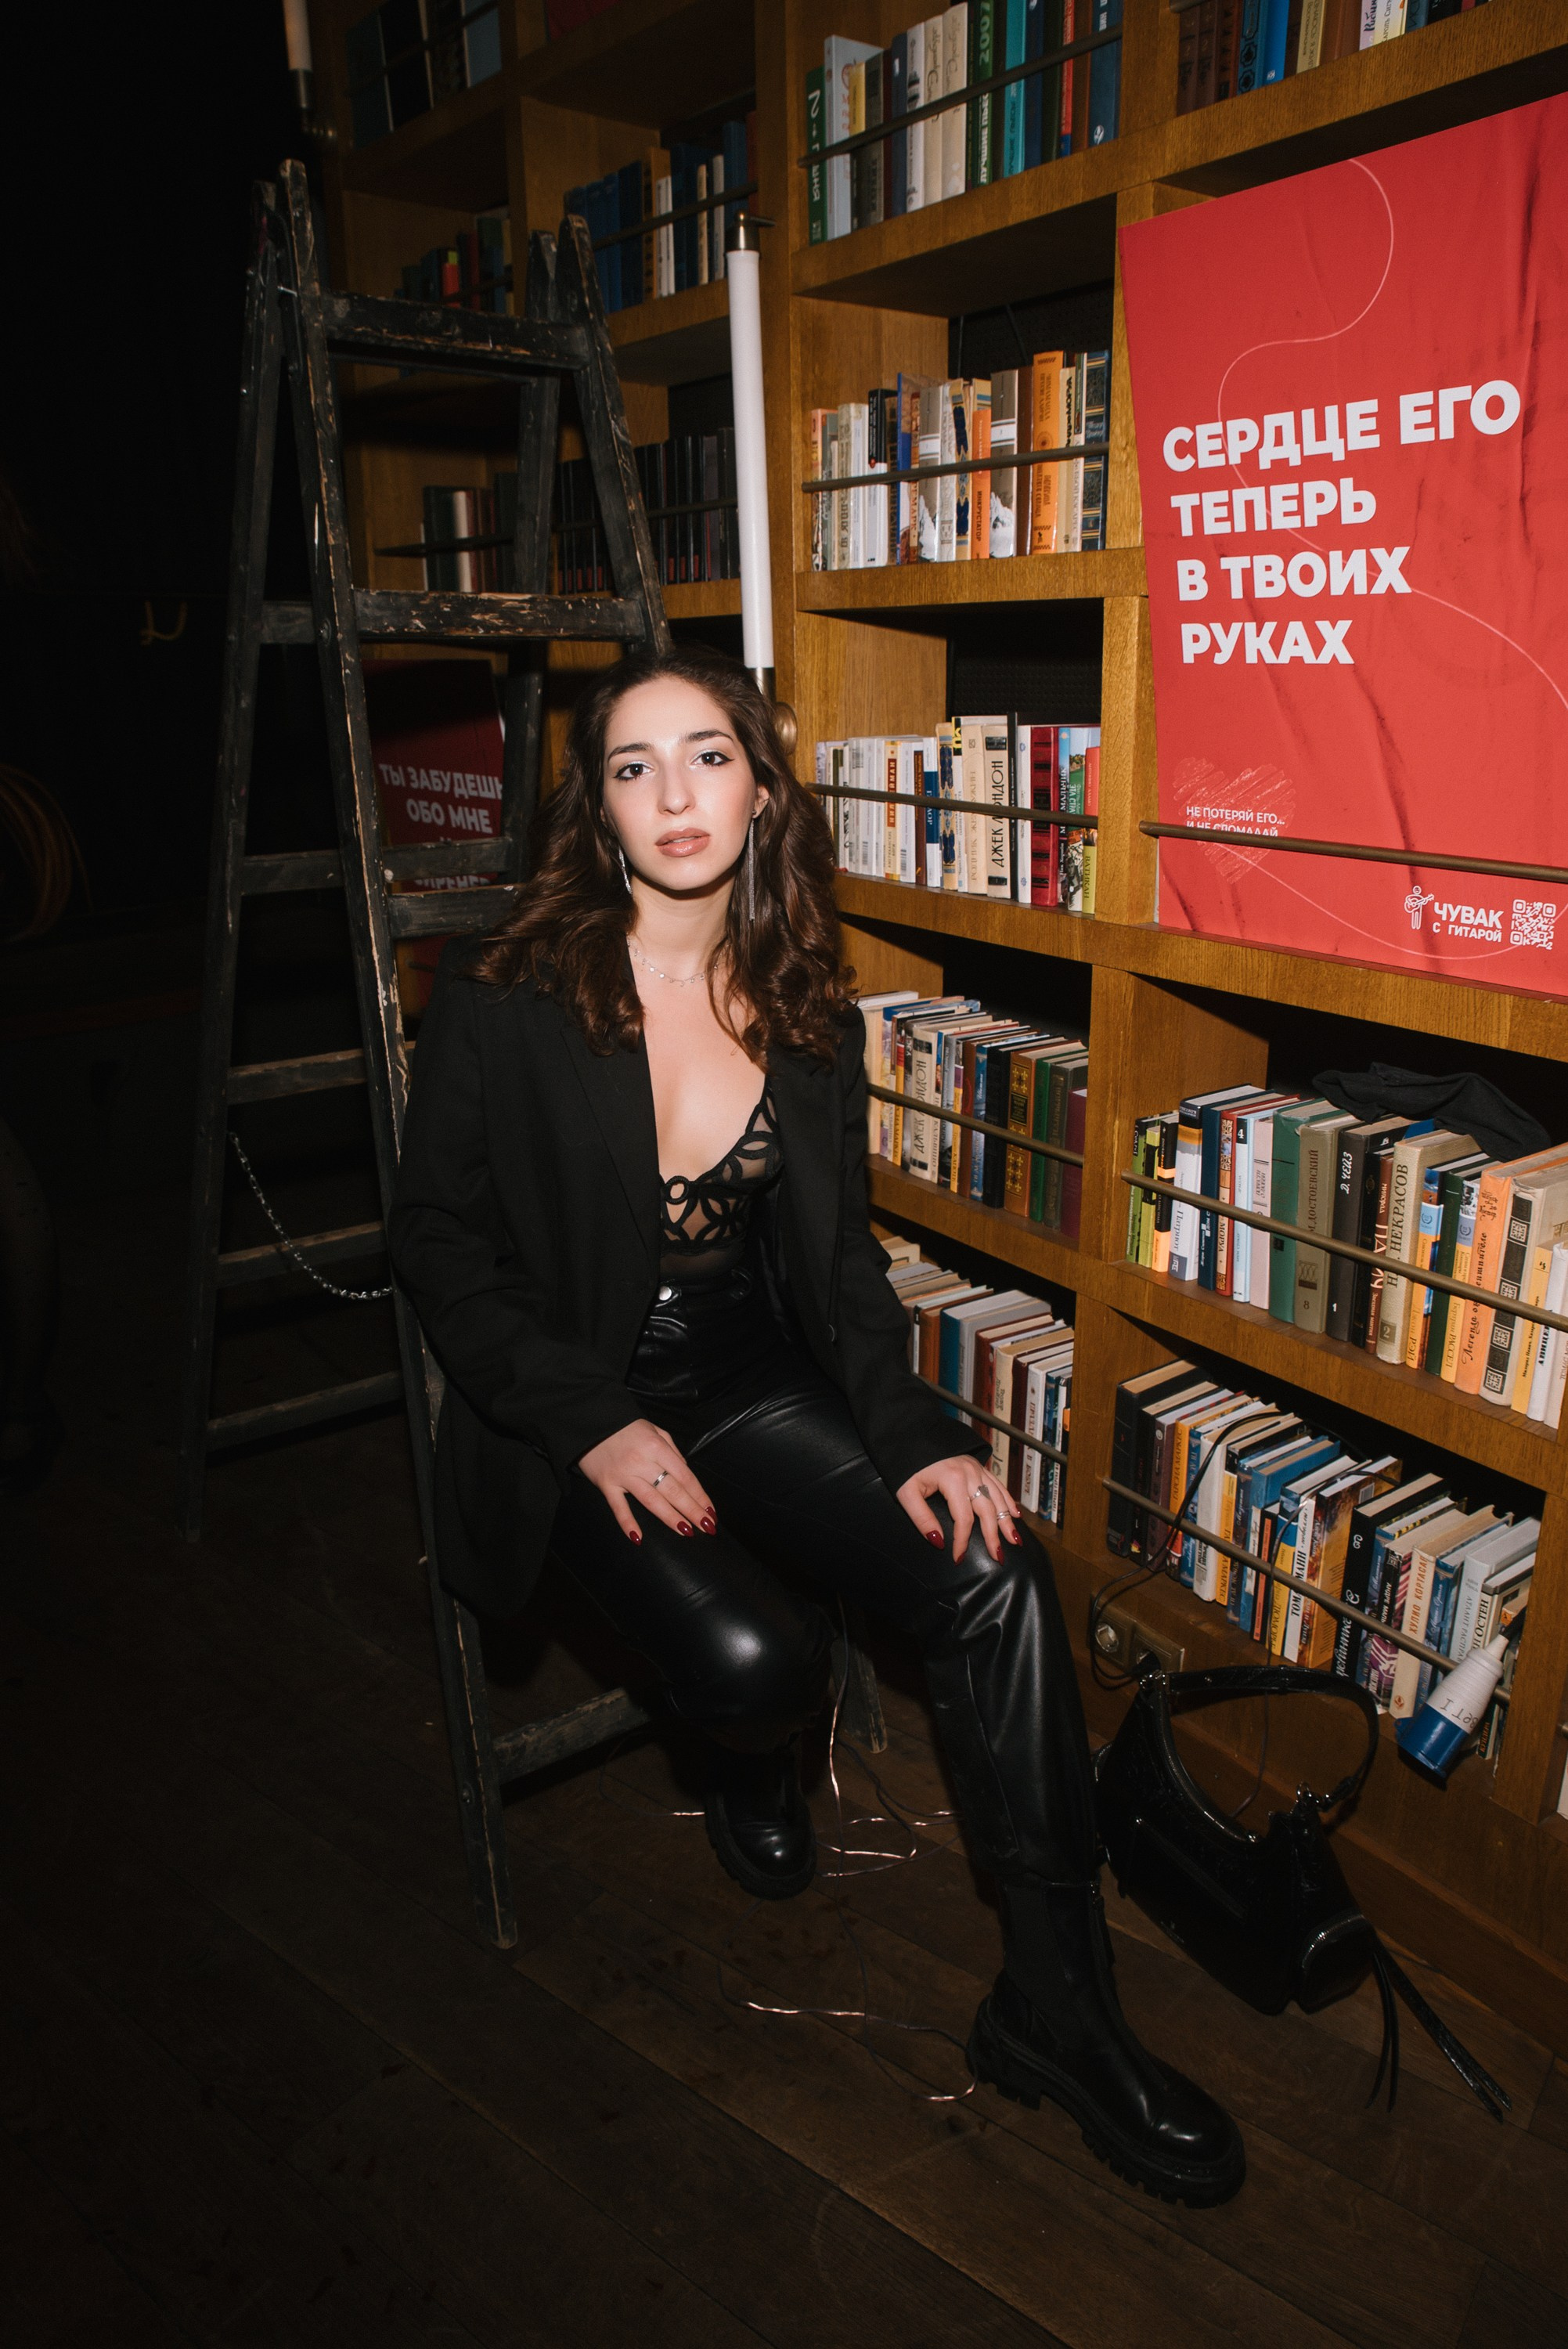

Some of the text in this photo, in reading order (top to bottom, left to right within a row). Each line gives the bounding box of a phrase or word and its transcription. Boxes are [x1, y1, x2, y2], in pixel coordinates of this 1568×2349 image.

[980, 92, 989, 127] ПЬЕС
[1163, 380, 1520, 471] СЕРДЦЕ ЕГО
[910, 482, 918, 532] РЕМАРК
[1170, 478, 1377, 536] ТЕПЕРЬ
[1177, 547, 1411, 601] В ТВОИХ
[1181, 620, 1354, 665] РУКАХ
[378, 763, 406, 788] ТЫ
[406, 798, 493, 835] ОБО МНЕ
[1186, 806, 1285, 825] НЕ ПОТЕРЯЙ ЕГО...
[969, 838, 978, 881] РОДНИК
[991, 828, 1004, 868] ДЖЕК
[1432, 922, 1502, 943] С ГИТАРОЙ
[1433, 901, 1505, 929] ЧУВАК
[913, 1118, 927, 1154] ДЖЕК
[1237, 1128, 1245, 1139] 4
[1342, 1151, 1354, 1179] ЧЕЙЗ
[1389, 1164, 1410, 1253] НЕКРАСОВ
[1173, 1210, 1184, 1251] Патриот
[1217, 1221, 1226, 1253] МОРУА
[1370, 1224, 1388, 1290] ПАИЧ
[1303, 1300, 1310, 1310] 8
[1462, 1315, 1480, 1365] Легенда
[1475, 1232, 1489, 1288] еншпигеле
[1382, 1326, 1391, 1339] 2
[1407, 1336, 1418, 1362] РЭЙ
[1444, 1301, 1461, 1369] Бертран РАССЕЛ
[1026, 1402, 1036, 1450] ПРАЗДК
[1172, 1428, 1183, 1501] ГАРСИА МАРКЕС
[1218, 1563, 1230, 1603] МАРКЕС
[1290, 1591, 1302, 1617] ТОМА
[1296, 1550, 1307, 1580] МАНН
[1381, 1582, 1393, 1623] АНДРЕ МАЛЬ
[1409, 1604, 1421, 1635] ХУЛИО
[1463, 1595, 1473, 1626] АТЛАНТ
[1475, 1598, 1490, 1637] ОСТЕН
[1479, 1722, 1491, 1754] КУНДЕРА
